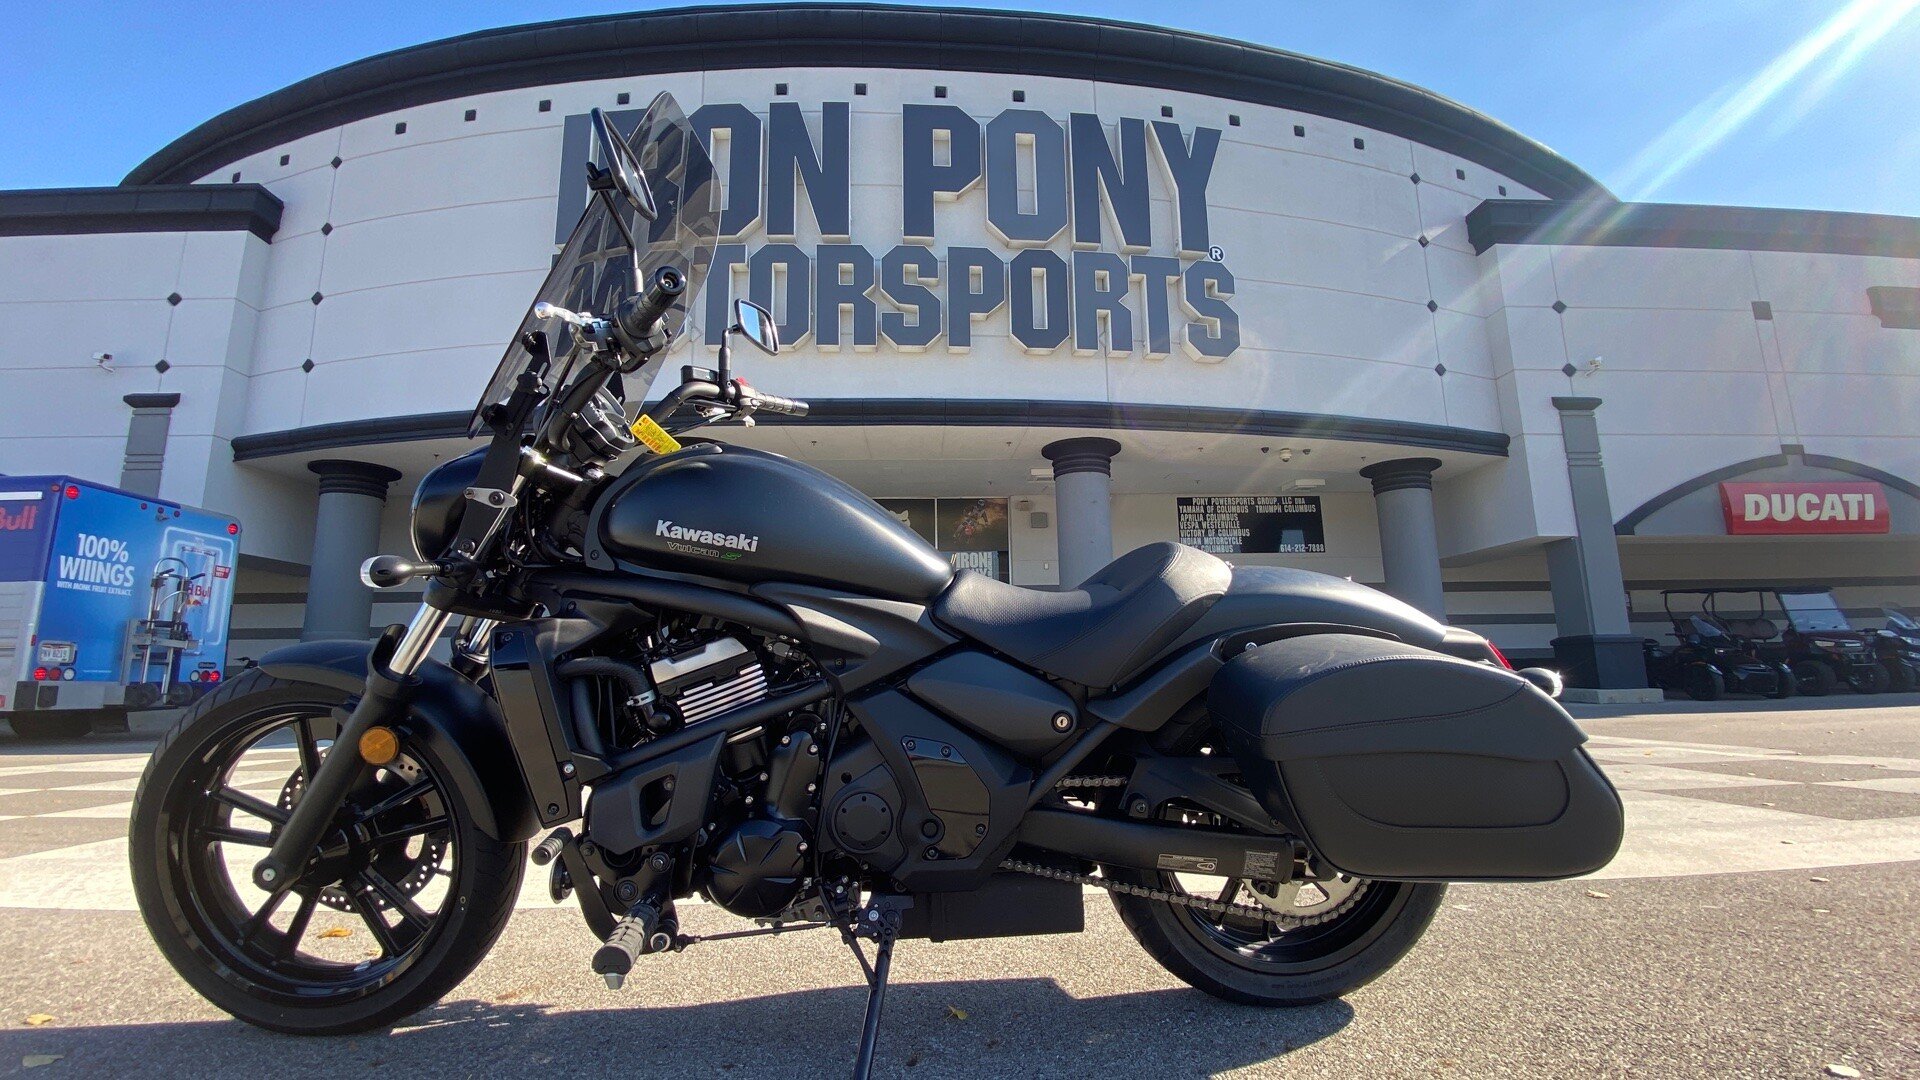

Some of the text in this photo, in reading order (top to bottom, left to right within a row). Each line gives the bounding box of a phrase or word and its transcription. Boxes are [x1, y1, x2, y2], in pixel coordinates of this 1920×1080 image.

[553, 101, 1223, 260] IRON PONY
[1192, 497, 1208, 505] PONY
[1211, 497, 1255, 505] POWERSPORTS
[1281, 496, 1292, 504] LLC
[1179, 505, 1249, 513] YAMAHA OF COLUMBUS
[1255, 504, 1316, 513] TRIUMPH COLUMBUS
[1743, 493, 1875, 522] DUCATI
[1180, 513, 1239, 522] APRILIA COLUMBUS
[1179, 521, 1240, 529] VESPA WESTERVILLE
[655, 519, 759, 553] Kawasaki
[1180, 528, 1250, 538] VICTORY OF COLUMBUS
[1204, 536, 1243, 545] MOTORCYCLE
[78, 533, 129, 563] 100%
[666, 541, 720, 558] Vulcan
[1201, 544, 1234, 553] COLUMBUS
[955, 551, 988, 568] IRON
[60, 555, 135, 587] WIIINGS
[56, 580, 72, 589] WITH
[92, 585, 107, 594] FRUIT
[107, 587, 133, 597] EXTRACT
